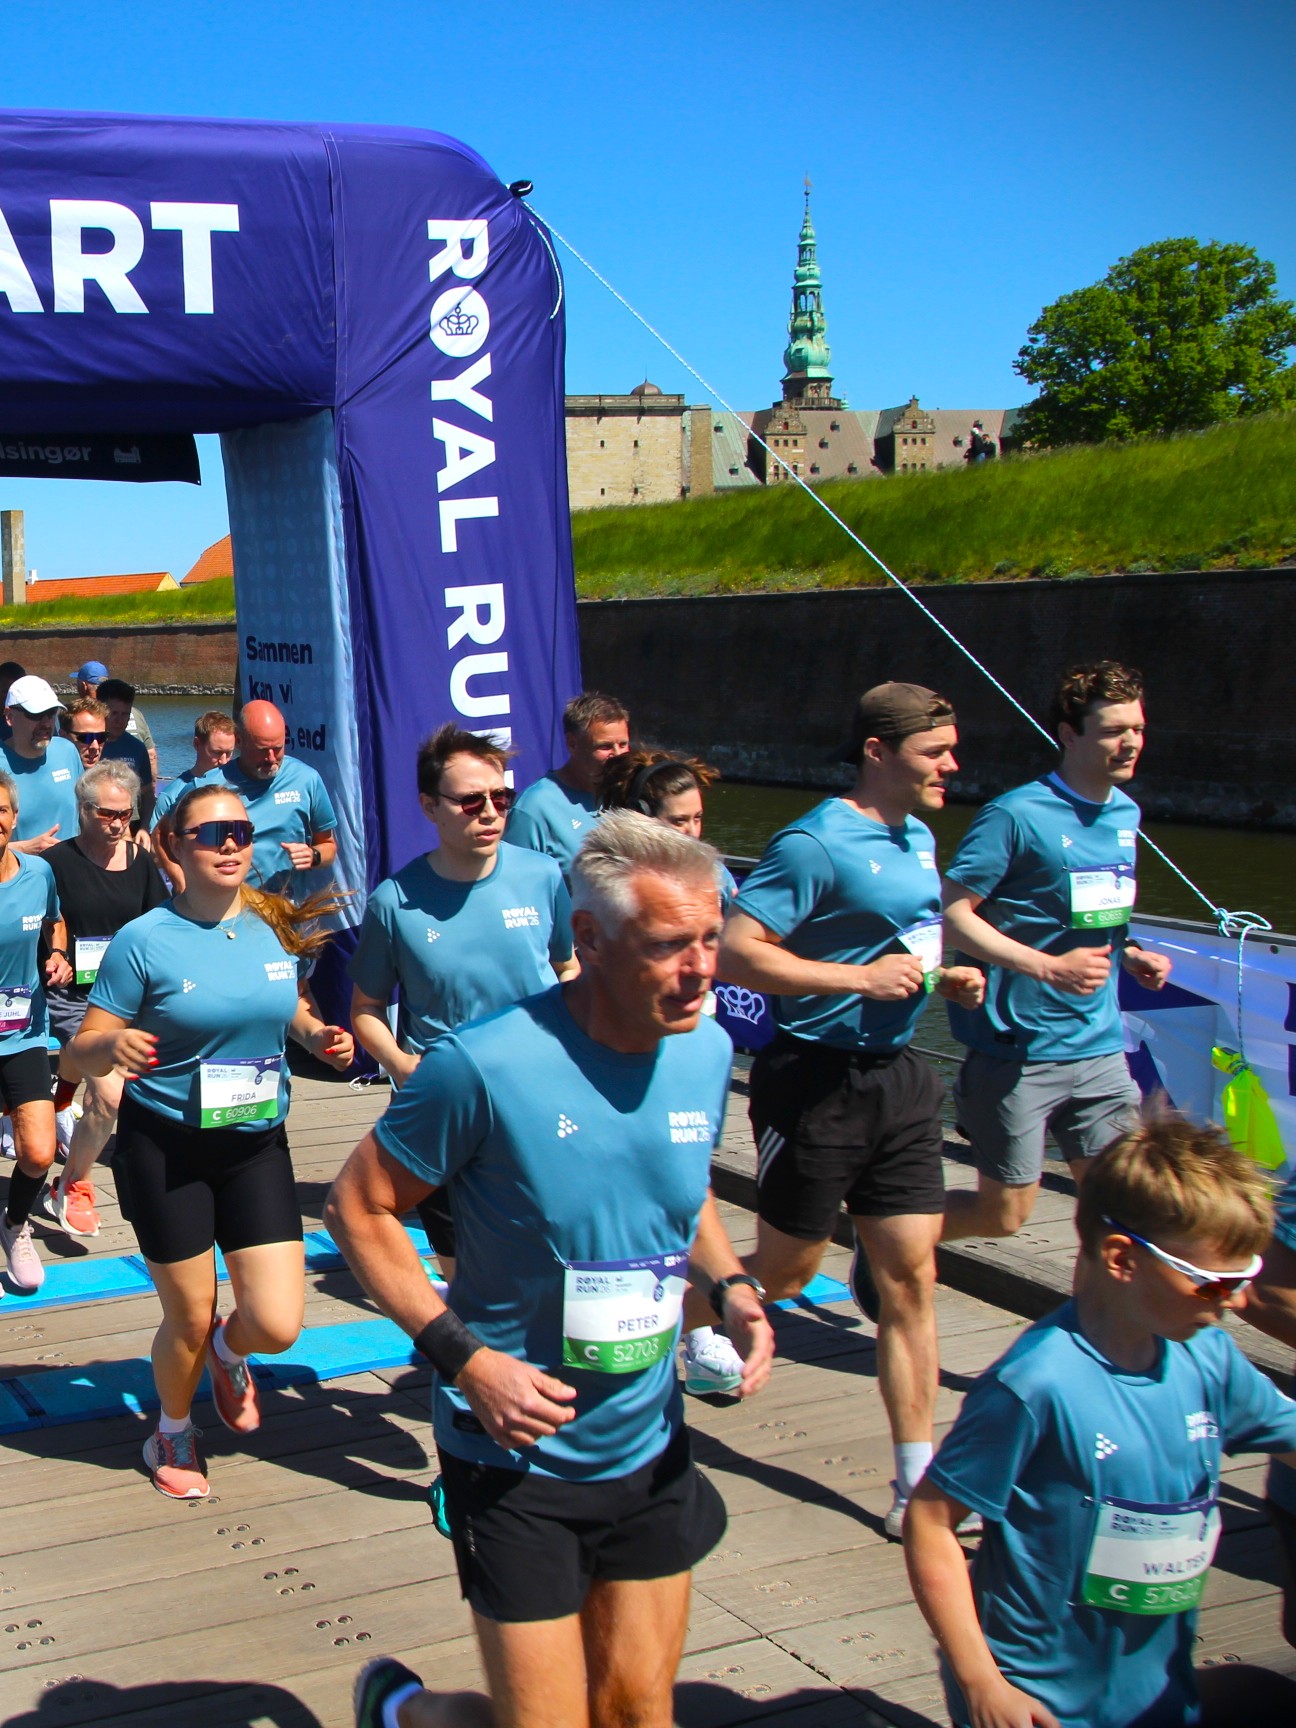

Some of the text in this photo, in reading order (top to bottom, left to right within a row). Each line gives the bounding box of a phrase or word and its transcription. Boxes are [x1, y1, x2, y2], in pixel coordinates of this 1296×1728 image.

[427, 218, 500, 554] ROYAL
[245, 635, 313, 665] Sammen
[298, 723, 326, 752] end
[274, 790, 300, 799] ROYAL
[1098, 896, 1122, 906] JONAS
[501, 905, 539, 919] ROYAL
[1083, 913, 1093, 923] C
[231, 1091, 257, 1103] FRIDA
[212, 1104, 258, 1121] C 60906
[668, 1110, 709, 1127] ROYAL
[575, 1276, 612, 1285] ROYAL
[617, 1313, 659, 1334] PETER
[584, 1337, 660, 1363] C 52703
[1142, 1551, 1206, 1577] WALTER
[1108, 1583, 1130, 1601] C
